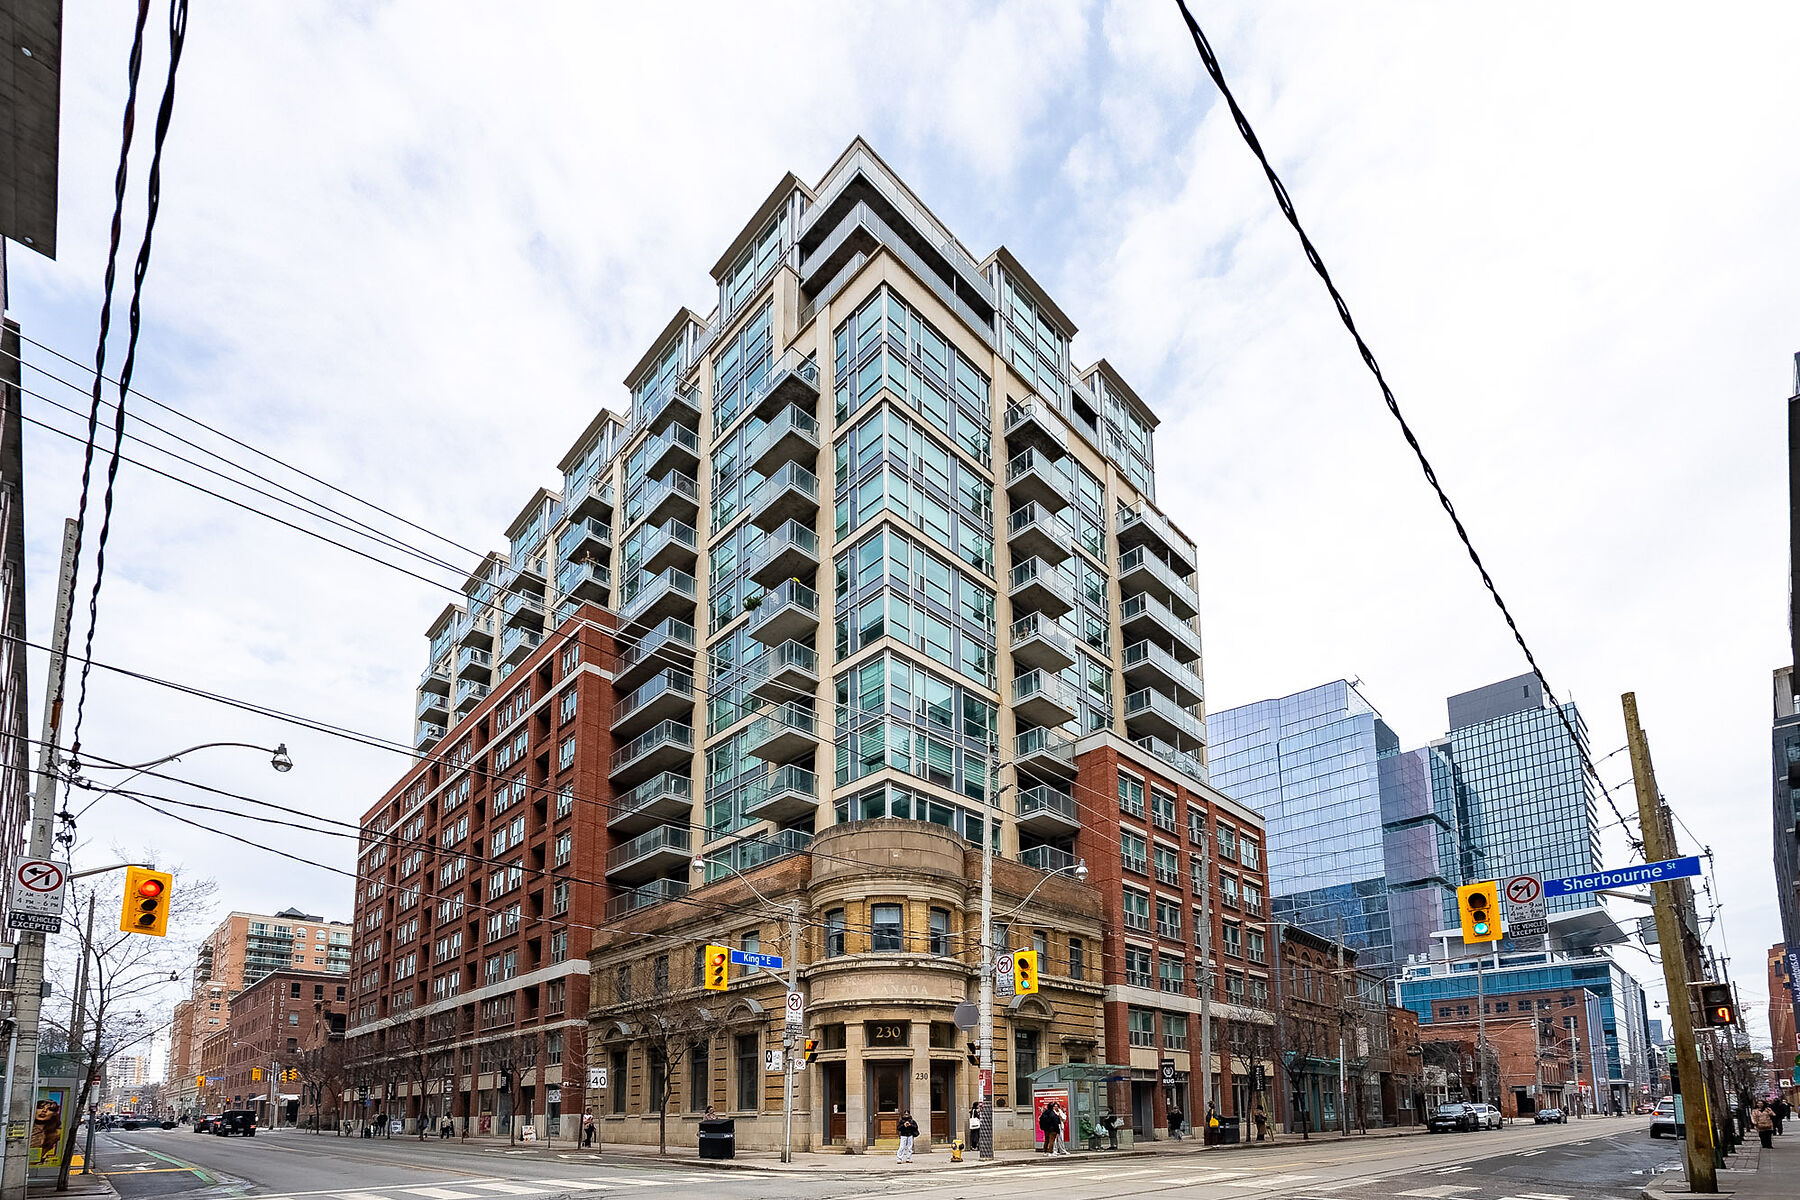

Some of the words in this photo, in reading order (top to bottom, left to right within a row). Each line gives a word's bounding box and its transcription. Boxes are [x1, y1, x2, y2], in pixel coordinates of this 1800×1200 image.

[1562, 866, 1663, 892] Sherbourne
[1666, 862, 1676, 870] St
[10, 913, 25, 921] TTC
[28, 915, 60, 925] VEHICLES
[1522, 920, 1547, 930] VEHICLES
[11, 920, 58, 932] EXCEPTED
[1511, 927, 1546, 937] EXCEPTED
[743, 953, 760, 966] King
[767, 957, 771, 965] E
[871, 985, 929, 995] CANADA
[279, 982, 287, 1020] STUDIO
[876, 1026, 901, 1039] 230
[592, 1076, 606, 1086] 40
[915, 1072, 929, 1081] 230
